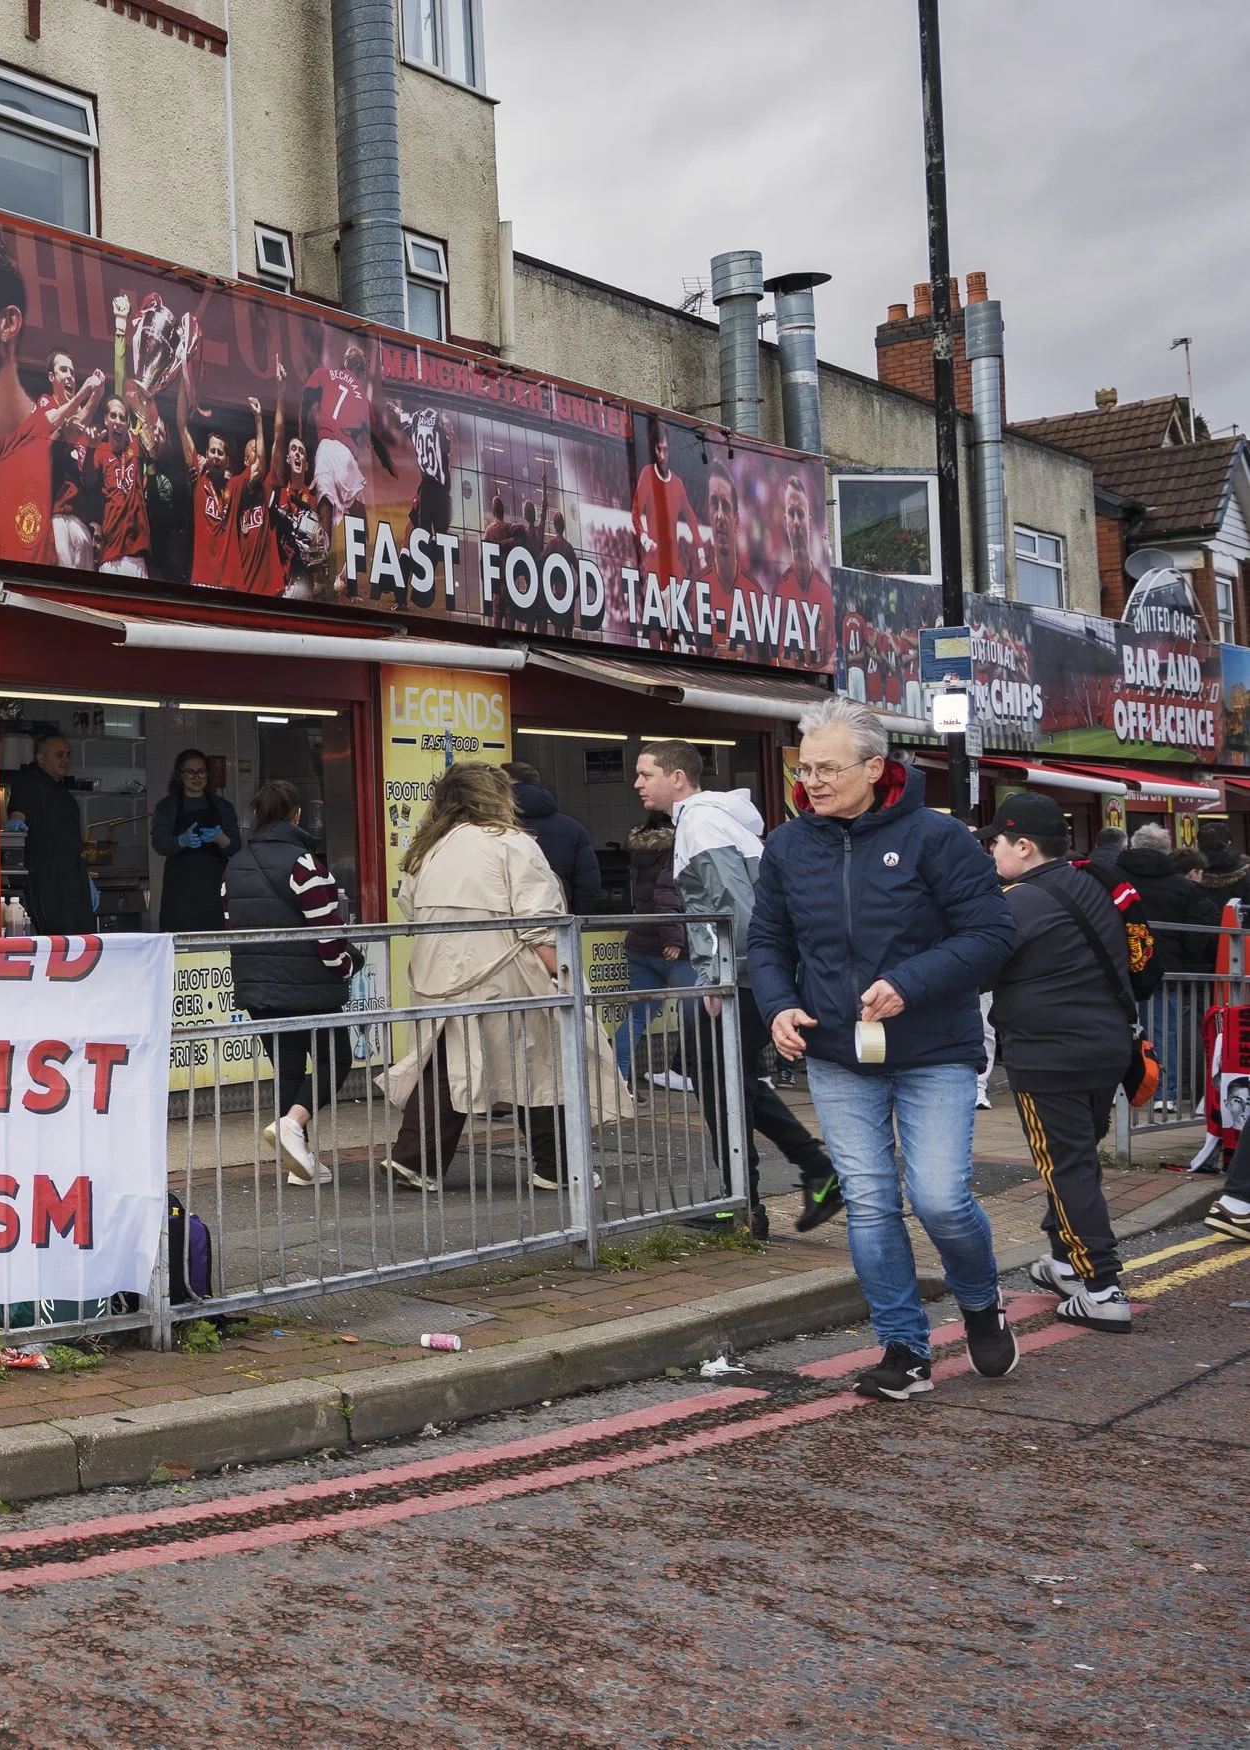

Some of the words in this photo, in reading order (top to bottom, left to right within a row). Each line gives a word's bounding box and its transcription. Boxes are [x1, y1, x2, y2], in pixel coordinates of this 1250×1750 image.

[329, 369, 363, 400] BECKHAM
[333, 384, 349, 421] 7
[344, 514, 460, 596] FAST
[481, 540, 605, 619] FOOD
[621, 567, 820, 652] TAKE-AWAY
[1133, 605, 1171, 634] UNITED
[1174, 610, 1197, 644] CAFE
[971, 638, 1016, 671] DITIONAL
[1122, 645, 1161, 688] BAR
[1166, 652, 1201, 693] AND
[390, 686, 505, 732] LEGENDS
[991, 679, 1043, 720] CHIPS
[1114, 699, 1147, 741] OFF
[1150, 703, 1215, 747] LICENCE
[421, 734, 448, 750] FAST
[450, 735, 479, 751] FOOD
[386, 781, 420, 801] FOOT
[421, 783, 435, 801] LO
[593, 942, 619, 961] FOOT
[178, 969, 210, 990] HOT
[211, 967, 233, 988] DO
[173, 994, 202, 1017] GER
[344, 996, 386, 1012] EGENDS
